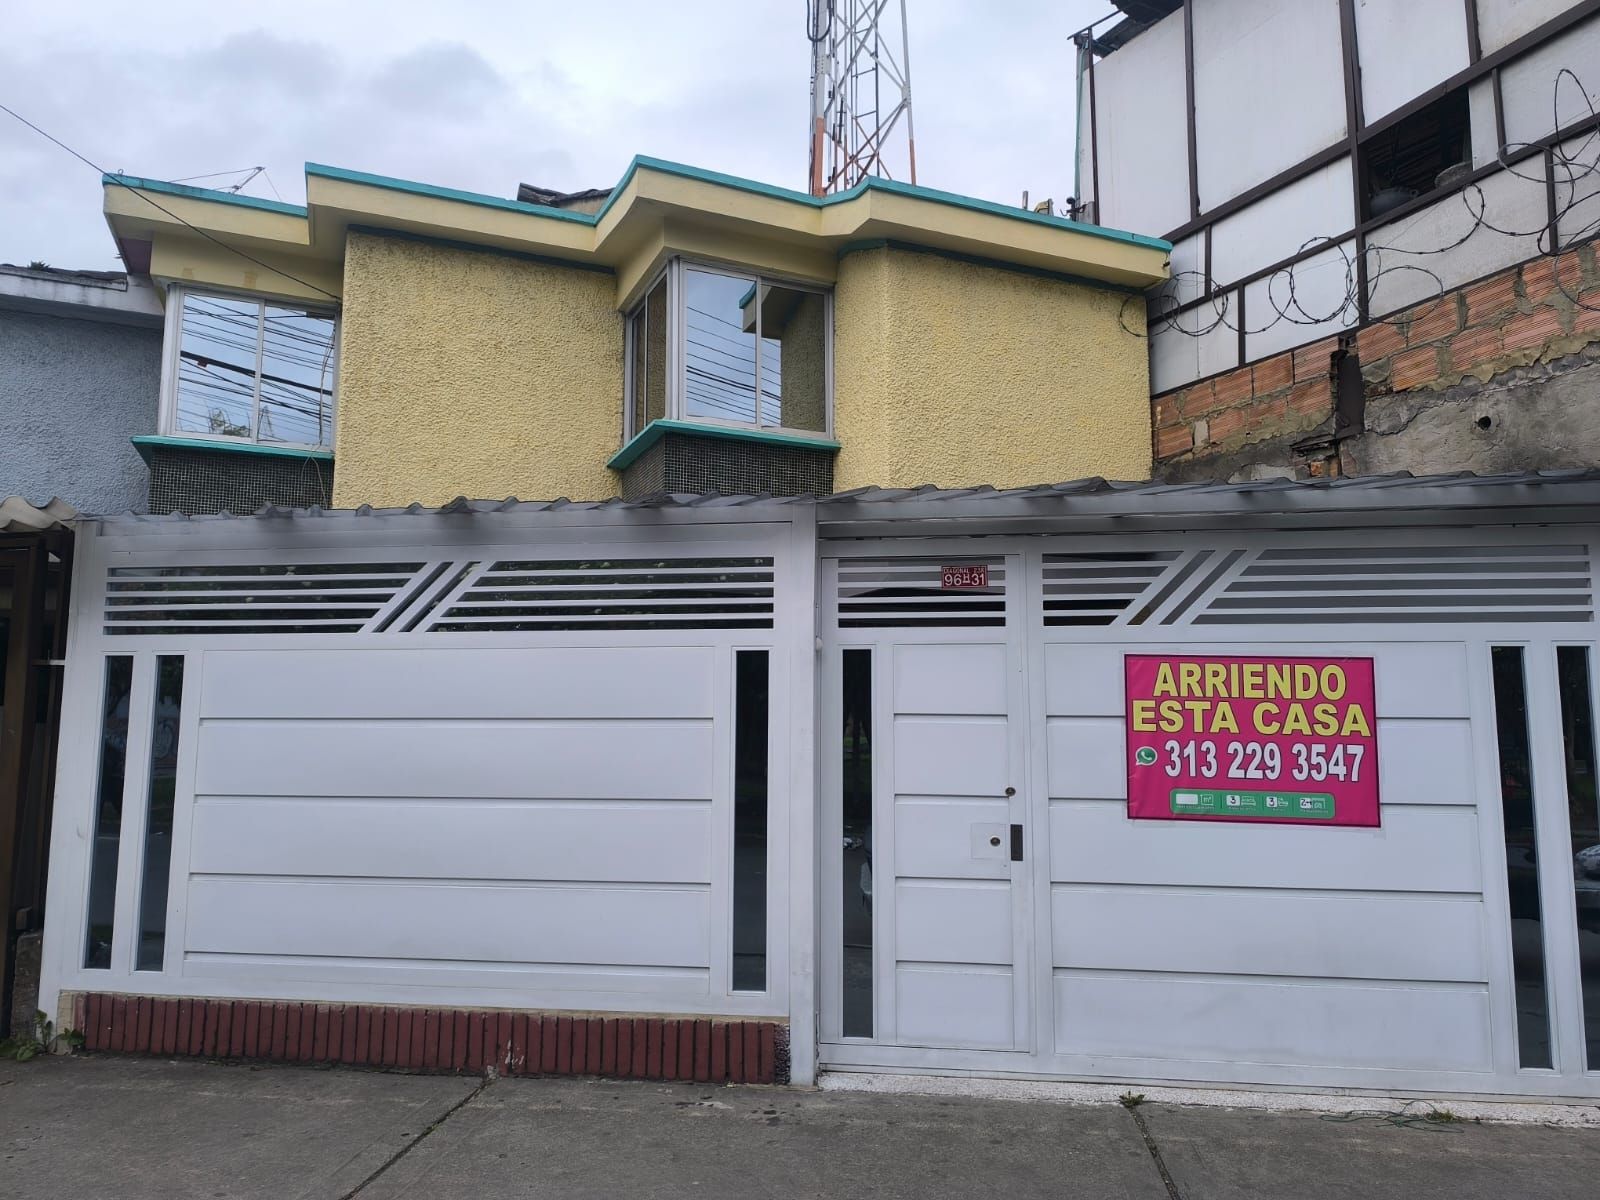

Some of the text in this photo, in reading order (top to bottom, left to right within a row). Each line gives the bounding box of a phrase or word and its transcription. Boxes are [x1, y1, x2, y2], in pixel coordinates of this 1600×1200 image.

[1153, 662, 1347, 700] ARRIENDO
[1132, 699, 1372, 737] ESTA CASA
[1164, 739, 1365, 782] 313 229 3547
